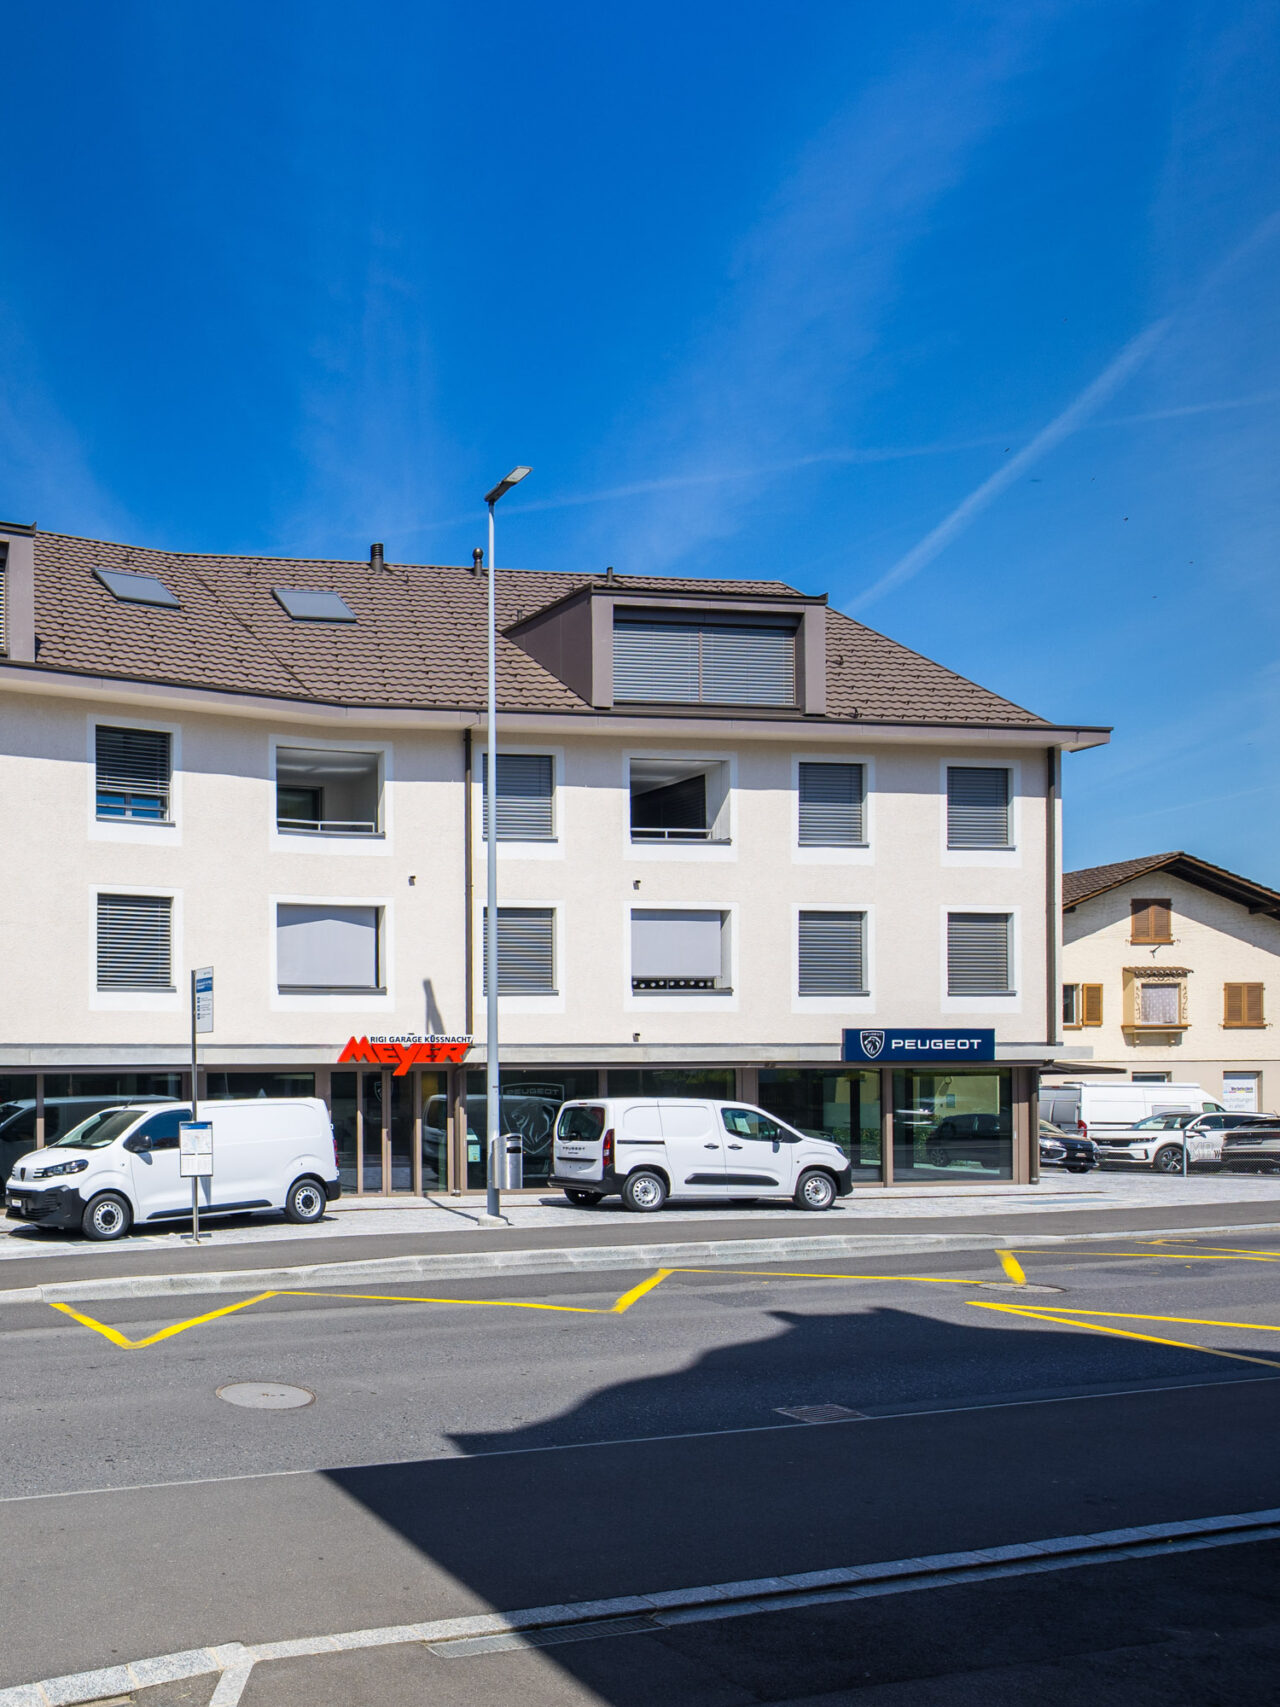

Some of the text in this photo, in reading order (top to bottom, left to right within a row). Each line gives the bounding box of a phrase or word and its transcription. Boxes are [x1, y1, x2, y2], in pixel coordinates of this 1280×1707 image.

[424, 1035, 471, 1043] KÜSSNACHT
[891, 1039, 982, 1050] PEUGEOT
[337, 1036, 470, 1076] MEYER
[506, 1087, 560, 1096] PEUGEOT
